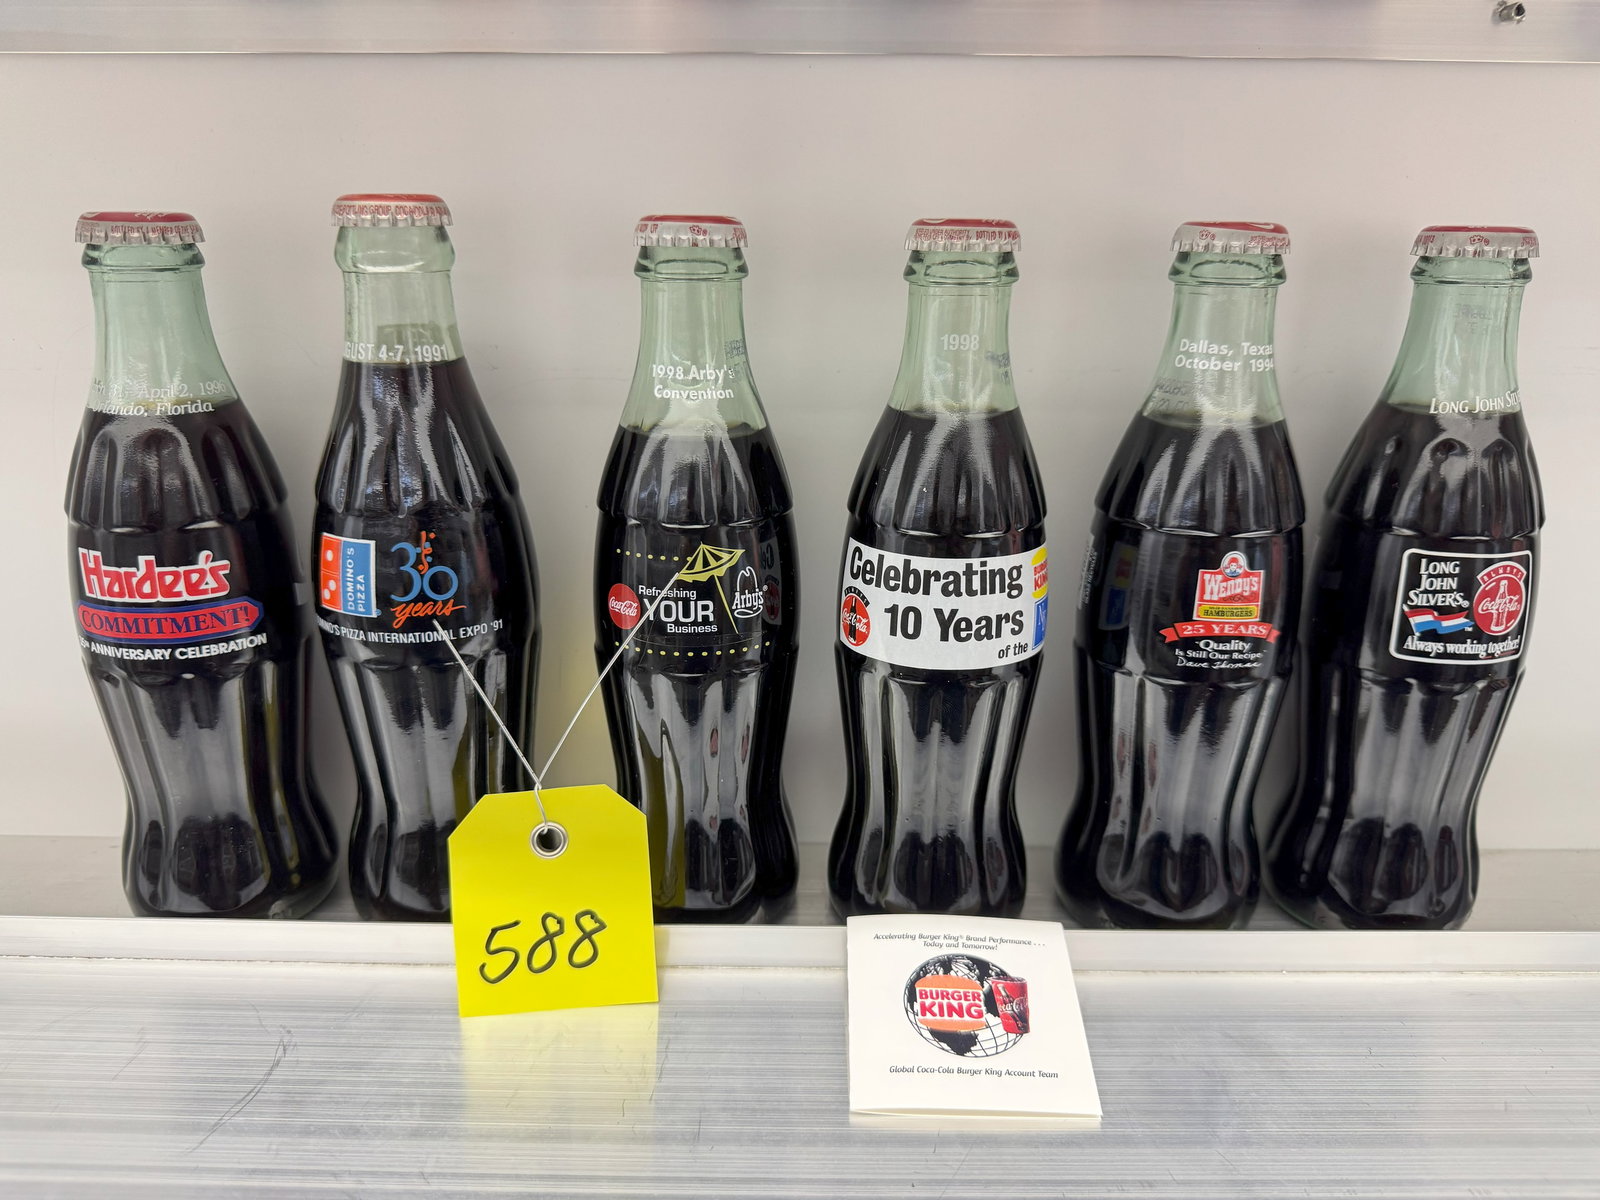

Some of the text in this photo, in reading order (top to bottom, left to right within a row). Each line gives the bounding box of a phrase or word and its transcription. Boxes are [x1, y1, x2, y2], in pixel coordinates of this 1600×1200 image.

[940, 334, 980, 351] 1998
[1179, 338, 1233, 357] Dallas,
[344, 341, 448, 365] GUST 4-7, 1991
[1174, 354, 1241, 371] October
[652, 364, 735, 384] 1998 Arby's
[137, 383, 175, 402] April
[654, 385, 734, 400] Convention
[92, 400, 215, 417] Orlando, Florida
[1429, 397, 1469, 414] LONG
[1471, 395, 1505, 413] JOHN
[78, 547, 231, 602] Hardee's
[849, 545, 1024, 600] Celebrating
[1419, 558, 1460, 575] LONG
[1482, 565, 1522, 583] ALWAYS
[346, 547, 355, 611] DOMINO'S
[1203, 573, 1259, 600] Wendy's
[1415, 574, 1458, 591] JOHN
[357, 573, 366, 612] PIZZA
[638, 585, 697, 600] Refreshing
[391, 598, 467, 629] years
[609, 596, 638, 617] Coca-Cola
[643, 598, 714, 622] YOUR
[1203, 609, 1253, 618] HAMBURGERS
[81, 605, 251, 634] COMMITMENT!
[667, 623, 718, 634] Business
[883, 603, 923, 640] 10
[933, 607, 1025, 642] Years
[341, 626, 366, 641] PIZZA
[368, 630, 457, 644] INTERNATIONAL
[459, 623, 488, 639] EXPO
[490, 619, 503, 631] '91
[1182, 624, 1267, 635] 25 YEARS
[90, 642, 172, 660] ANNIVERSARY
[175, 632, 267, 660] CELEBRATION
[997, 642, 1028, 659] of the
[1175, 648, 1185, 656] Is
[1186, 649, 1206, 658] Still
[1208, 651, 1229, 660] Our
[1403, 635, 1521, 659] Always working together!
[1176, 656, 1210, 668] Dave
[478, 908, 608, 985] 588
[873, 932, 917, 941] Accelerating
[918, 933, 941, 942] Burger
[965, 935, 987, 943] Brand
[988, 936, 1032, 946] Performance
[923, 940, 943, 949] Today
[961, 941, 998, 951] Tomorrow!
[918, 989, 982, 1002] BURGER
[920, 1001, 984, 1019] KING
[889, 1065, 1059, 1078] Global Coca-Cola Burger King Account Team
